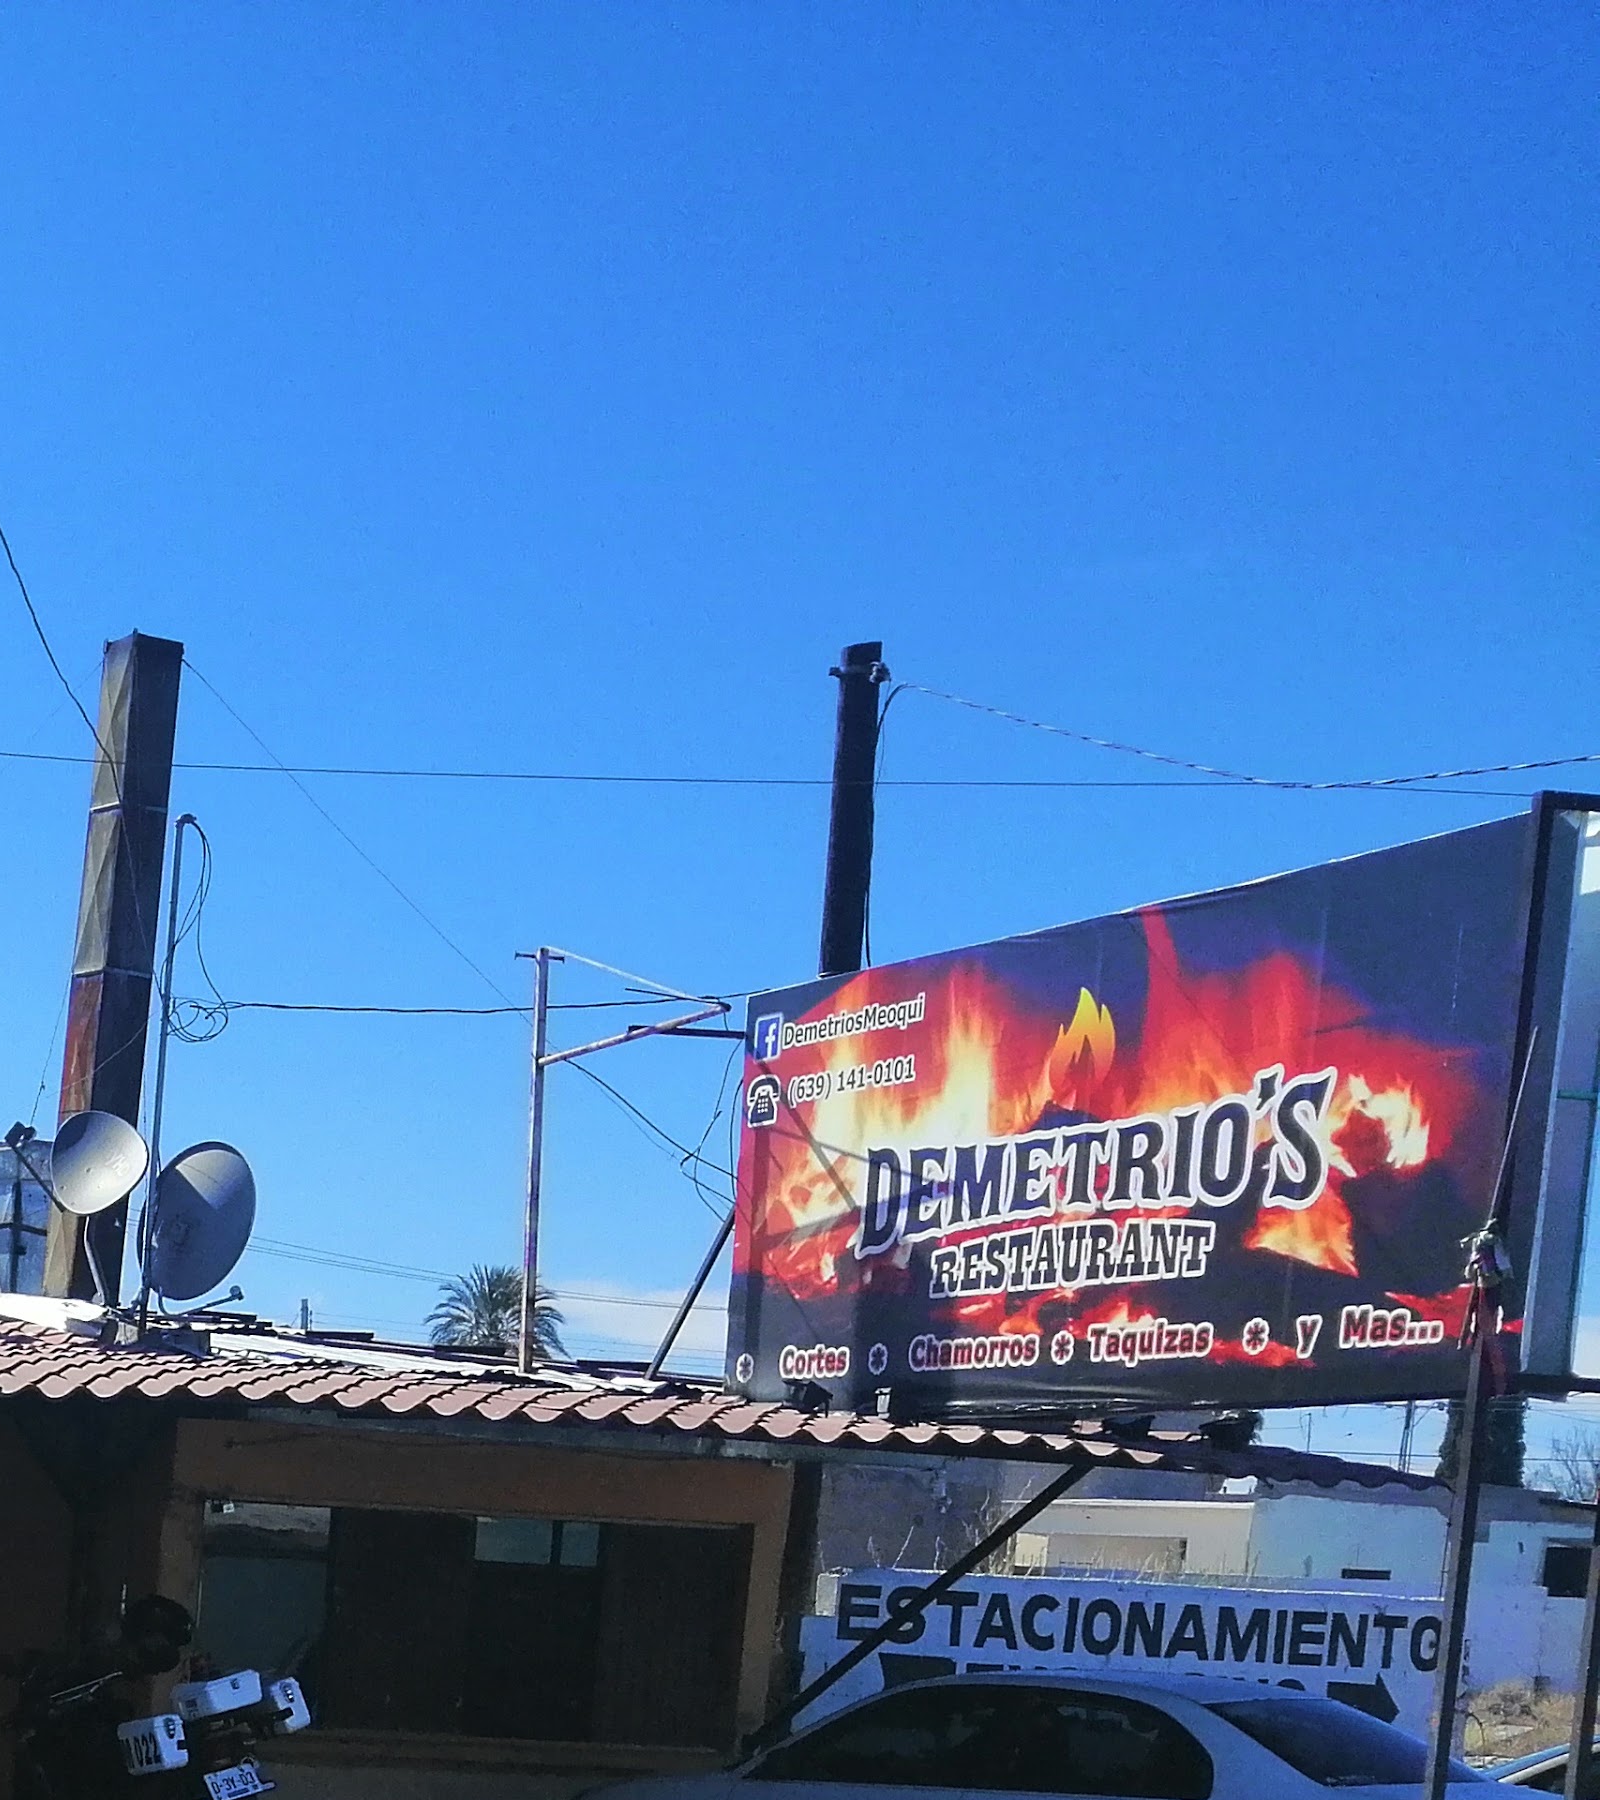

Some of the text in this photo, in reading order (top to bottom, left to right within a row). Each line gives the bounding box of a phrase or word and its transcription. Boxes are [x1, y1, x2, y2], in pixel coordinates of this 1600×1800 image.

[783, 993, 925, 1049] DemetriosMeoqui
[788, 1055, 915, 1108] (639) 141-0101
[856, 1064, 1336, 1259] DEMETRIO'S
[929, 1220, 1214, 1298] RESTAURANT
[779, 1344, 849, 1379] Cortes
[909, 1334, 1041, 1372] Chamorros
[1087, 1317, 1213, 1368] Taquizas
[1296, 1315, 1322, 1359] y
